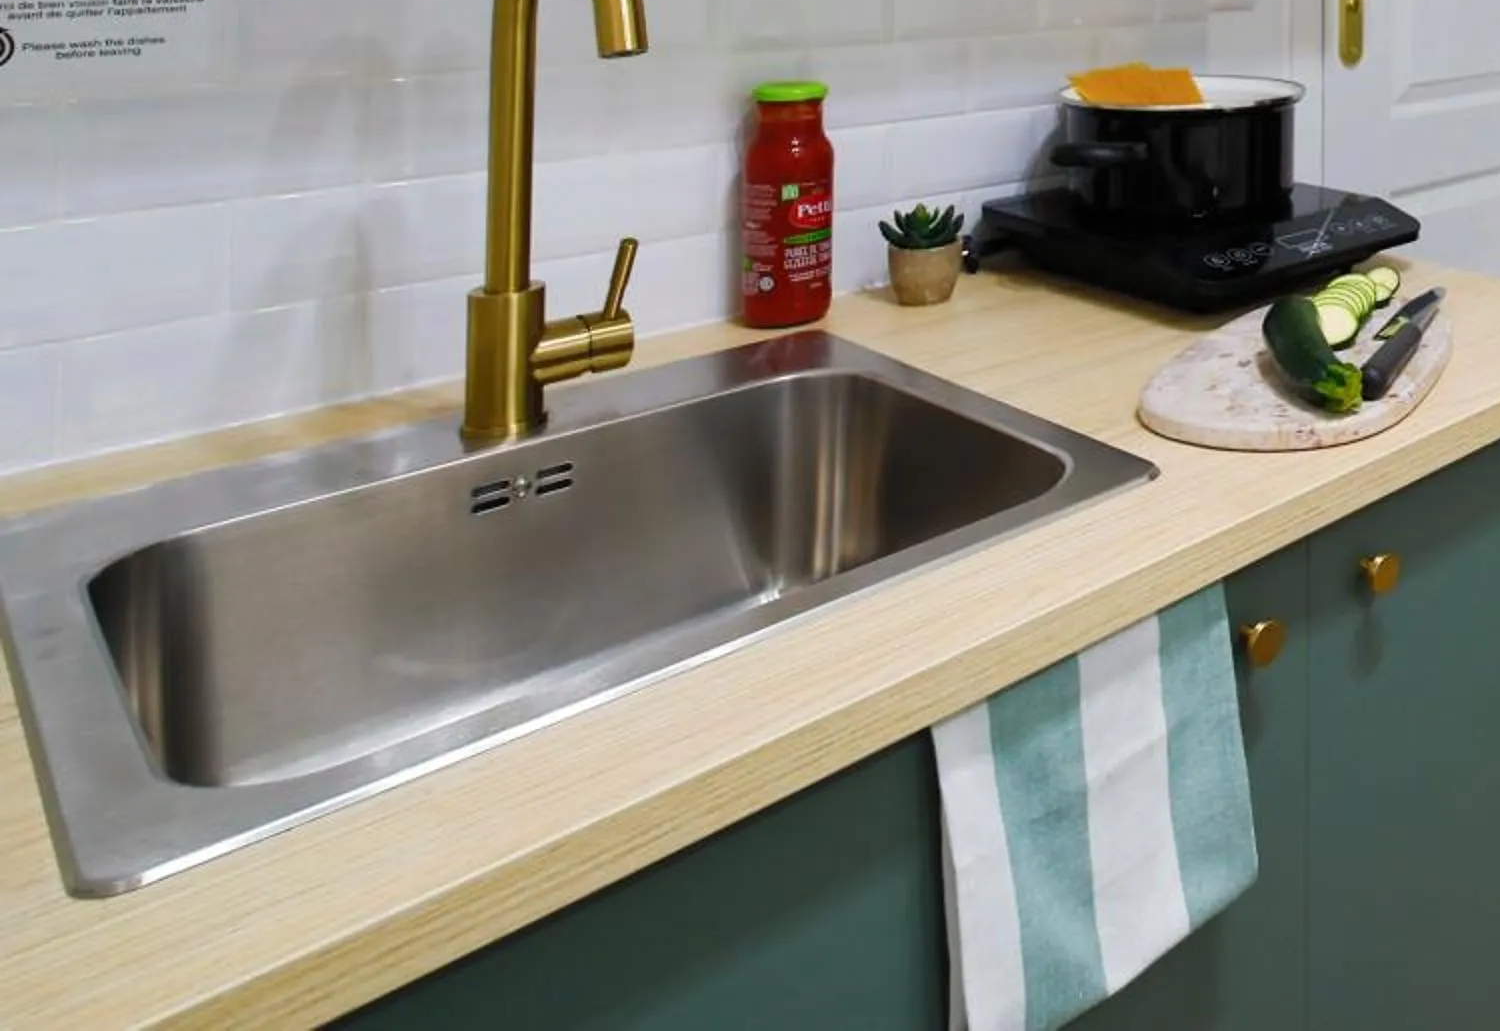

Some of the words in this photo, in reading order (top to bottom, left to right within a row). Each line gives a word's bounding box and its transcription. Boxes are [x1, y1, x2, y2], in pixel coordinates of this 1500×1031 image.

[18, 1, 35, 10] de
[38, 0, 65, 10] bien
[7, 10, 43, 20] avant
[46, 10, 62, 18] de
[66, 8, 104, 19] quitter
[22, 41, 66, 51] Please
[68, 39, 101, 49] wash
[104, 37, 124, 47] the
[127, 36, 166, 46] dishes
[55, 48, 96, 60] before
[98, 46, 142, 57] leaving
